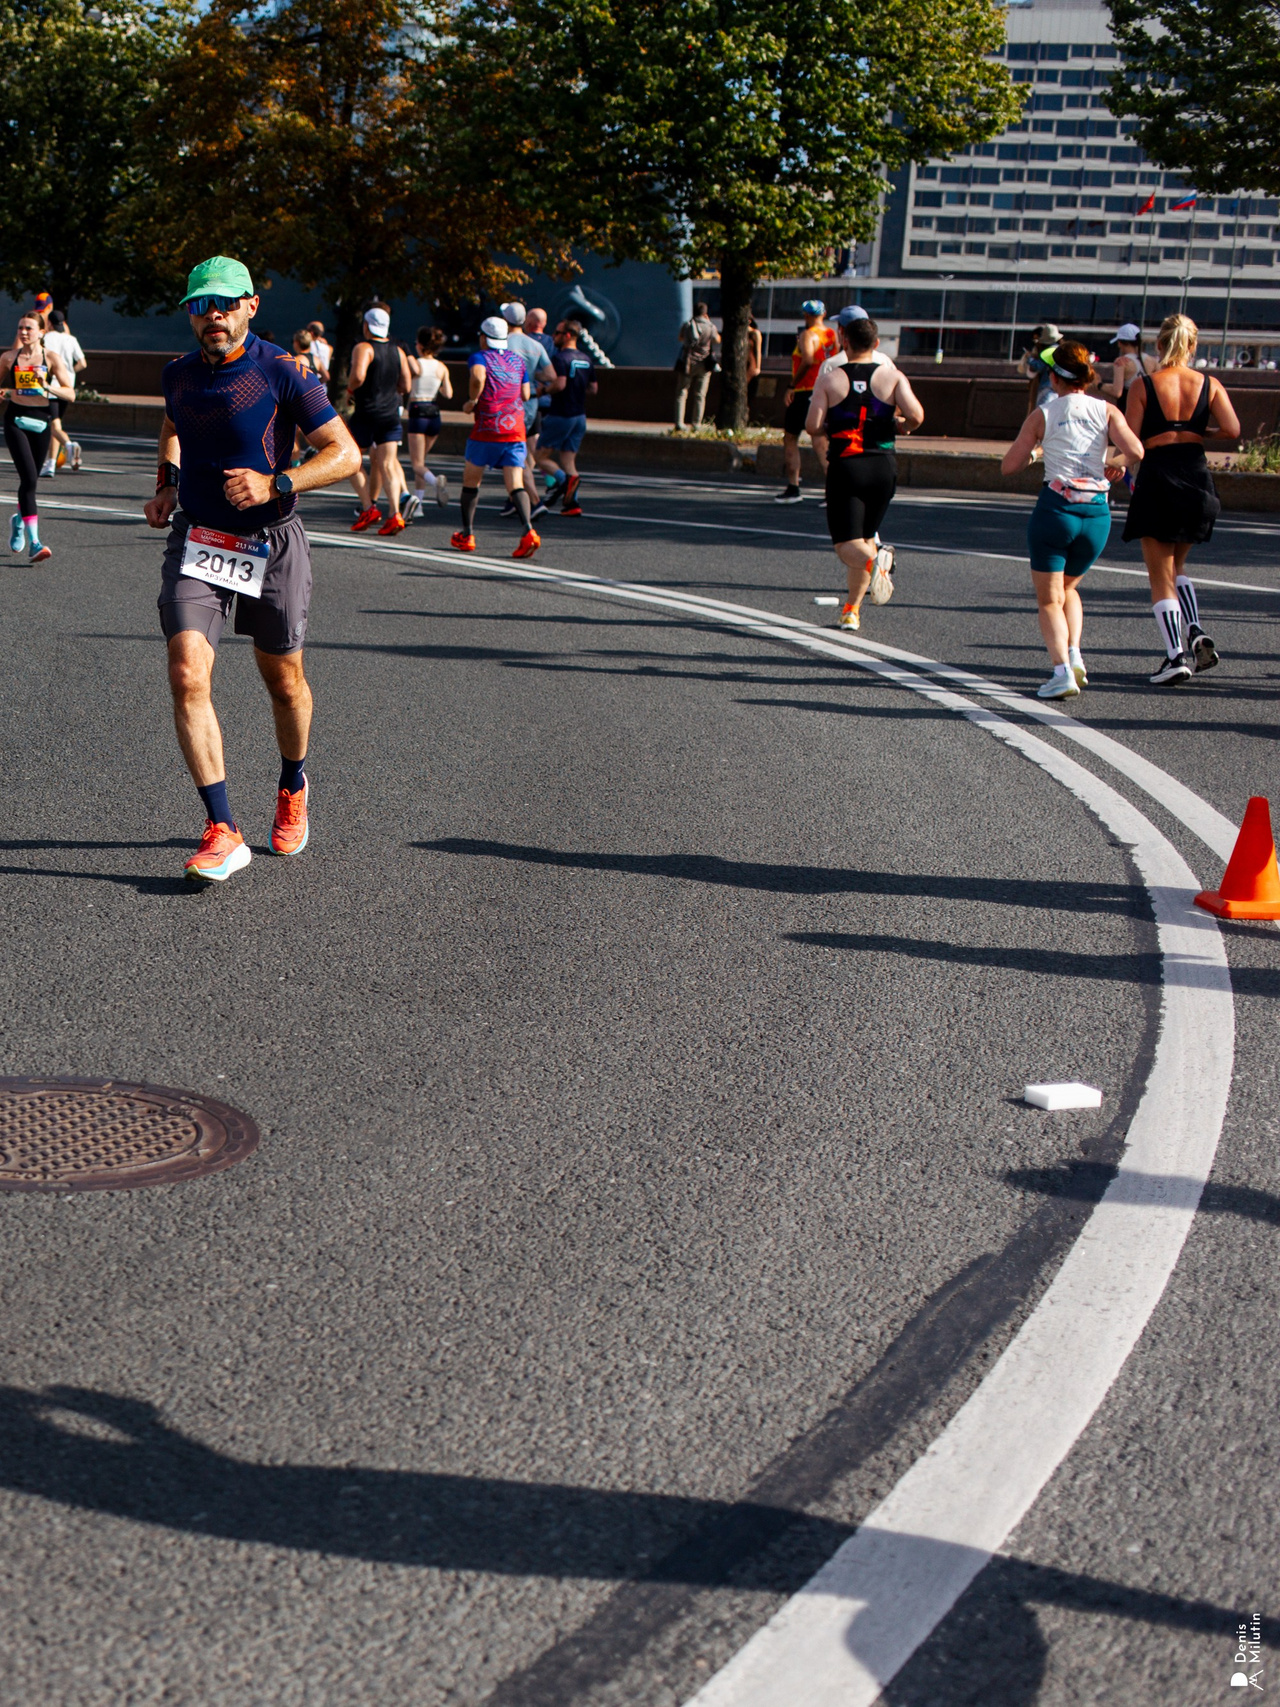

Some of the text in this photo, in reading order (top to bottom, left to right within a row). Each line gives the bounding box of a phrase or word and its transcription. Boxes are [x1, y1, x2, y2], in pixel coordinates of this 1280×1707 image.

[235, 541, 259, 553] 21,1 КМ
[195, 550, 254, 582] 2013
[204, 572, 239, 587] АРЗУМАН
